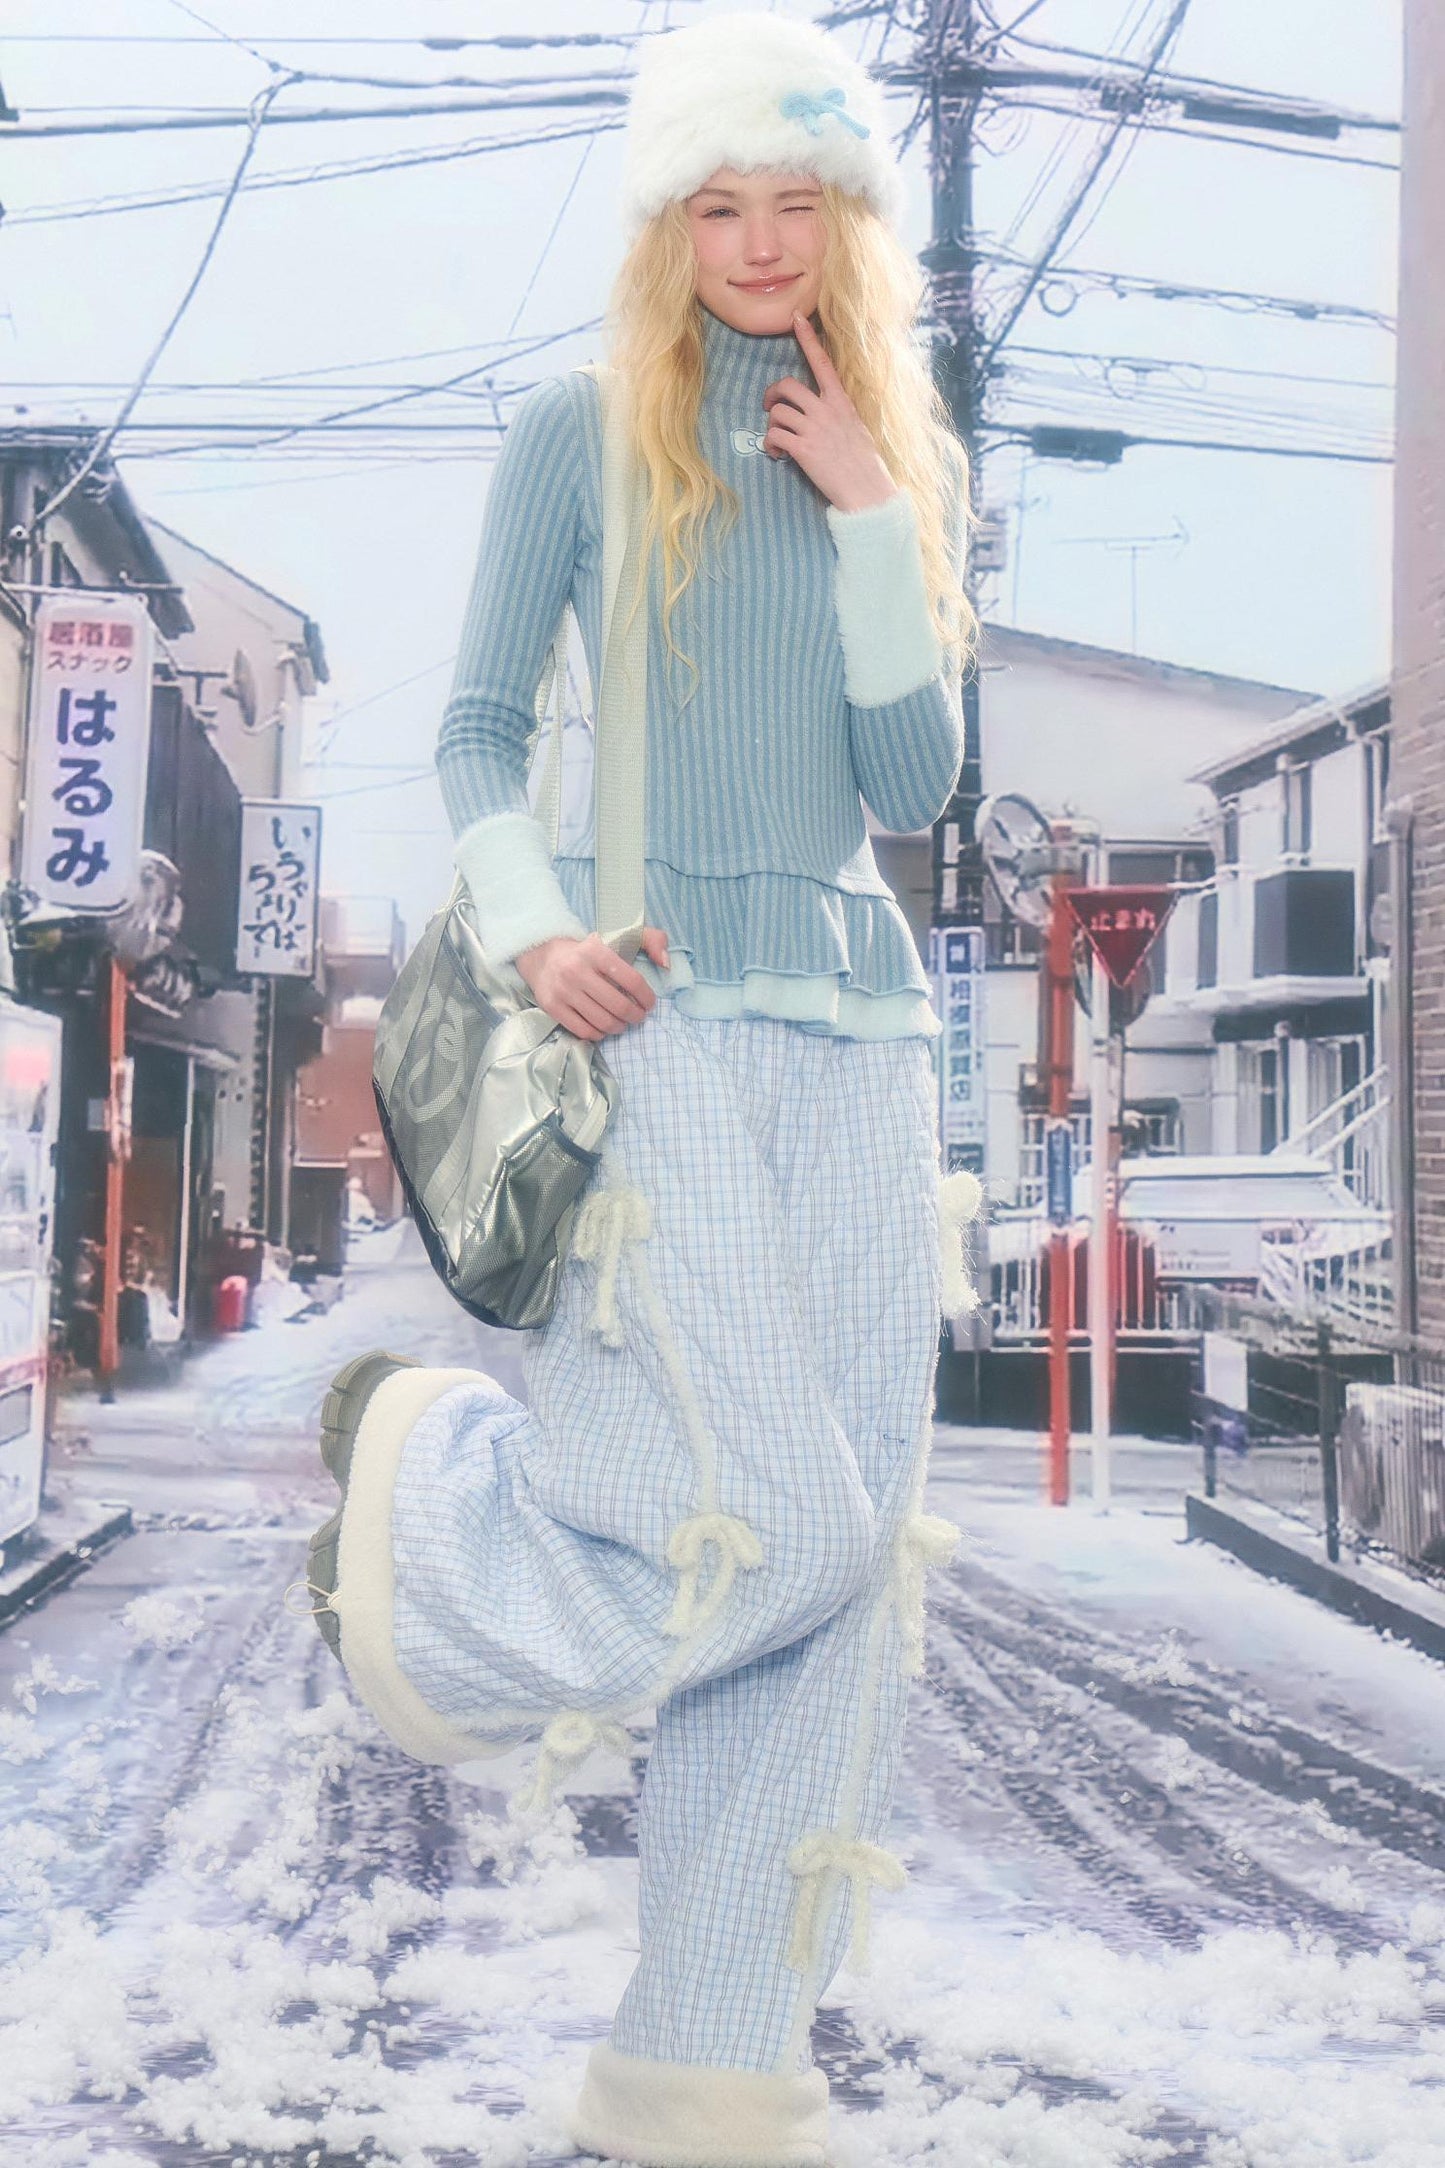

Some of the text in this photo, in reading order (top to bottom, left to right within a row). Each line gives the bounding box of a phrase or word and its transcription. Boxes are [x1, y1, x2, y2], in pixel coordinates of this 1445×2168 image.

[47, 651, 132, 674] スナック
[47, 687, 117, 886] はるみ
